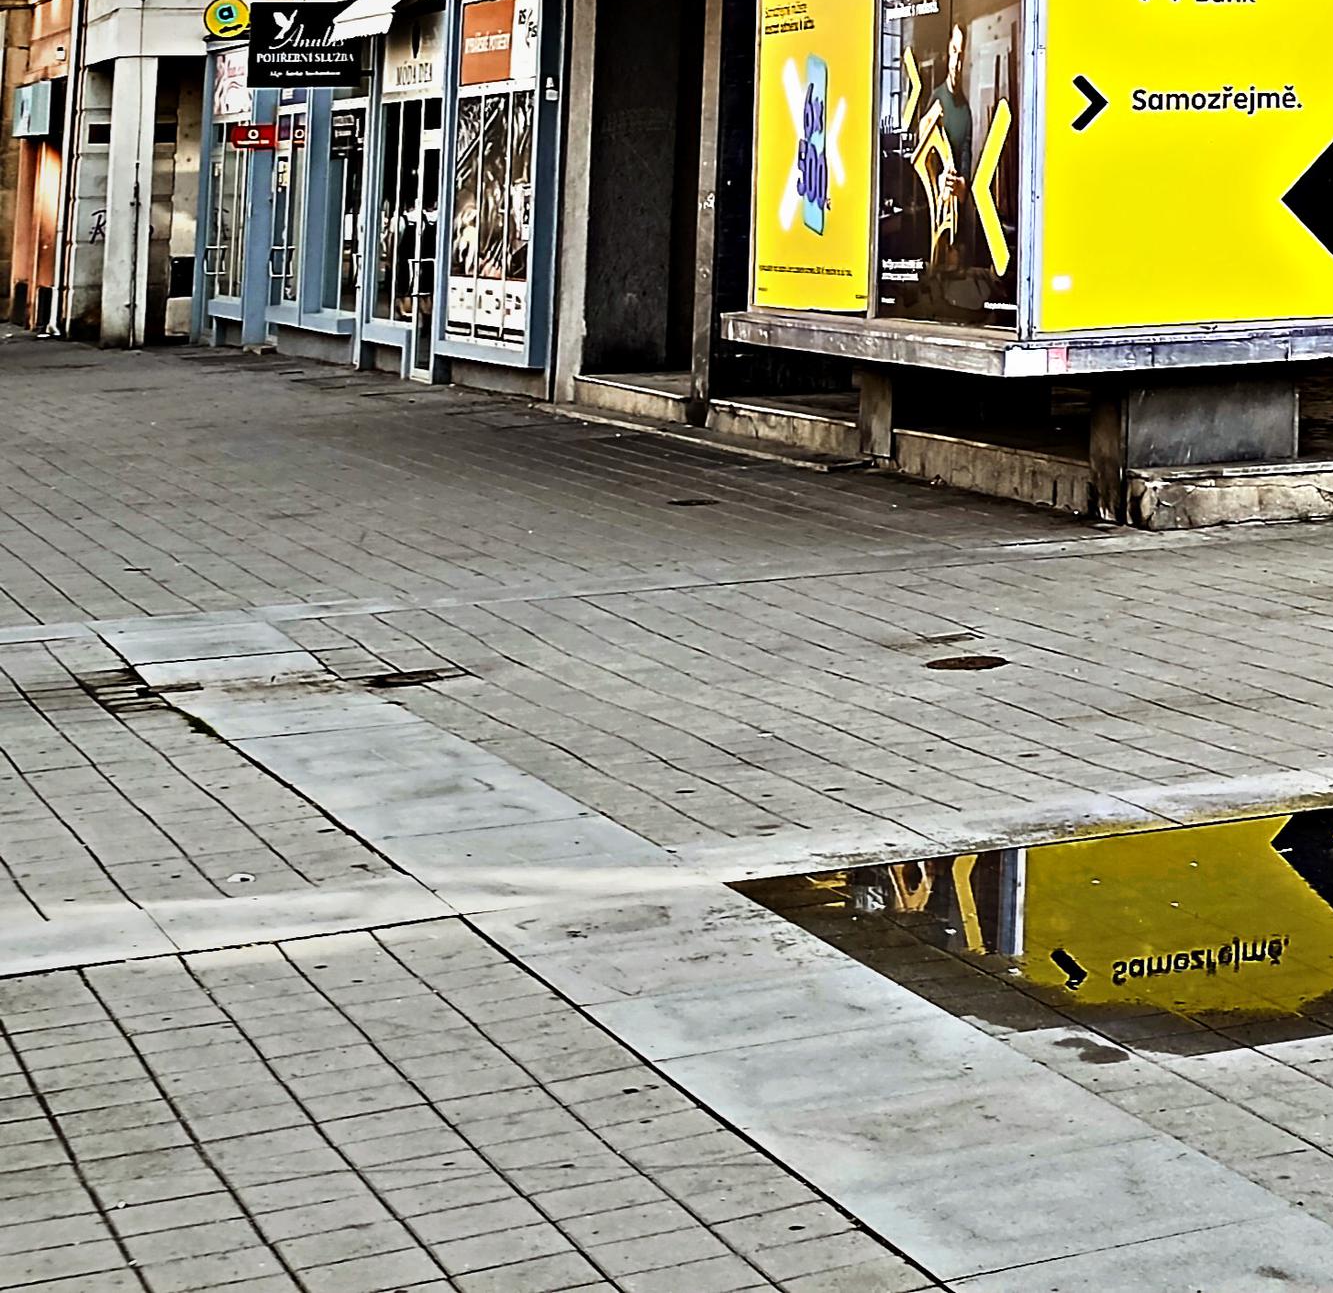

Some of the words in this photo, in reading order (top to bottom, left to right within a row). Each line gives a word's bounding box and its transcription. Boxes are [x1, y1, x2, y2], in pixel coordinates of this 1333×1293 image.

[804, 83, 824, 142] 6x
[1131, 85, 1303, 115] Samozřejmě.
[796, 139, 828, 210] 500
